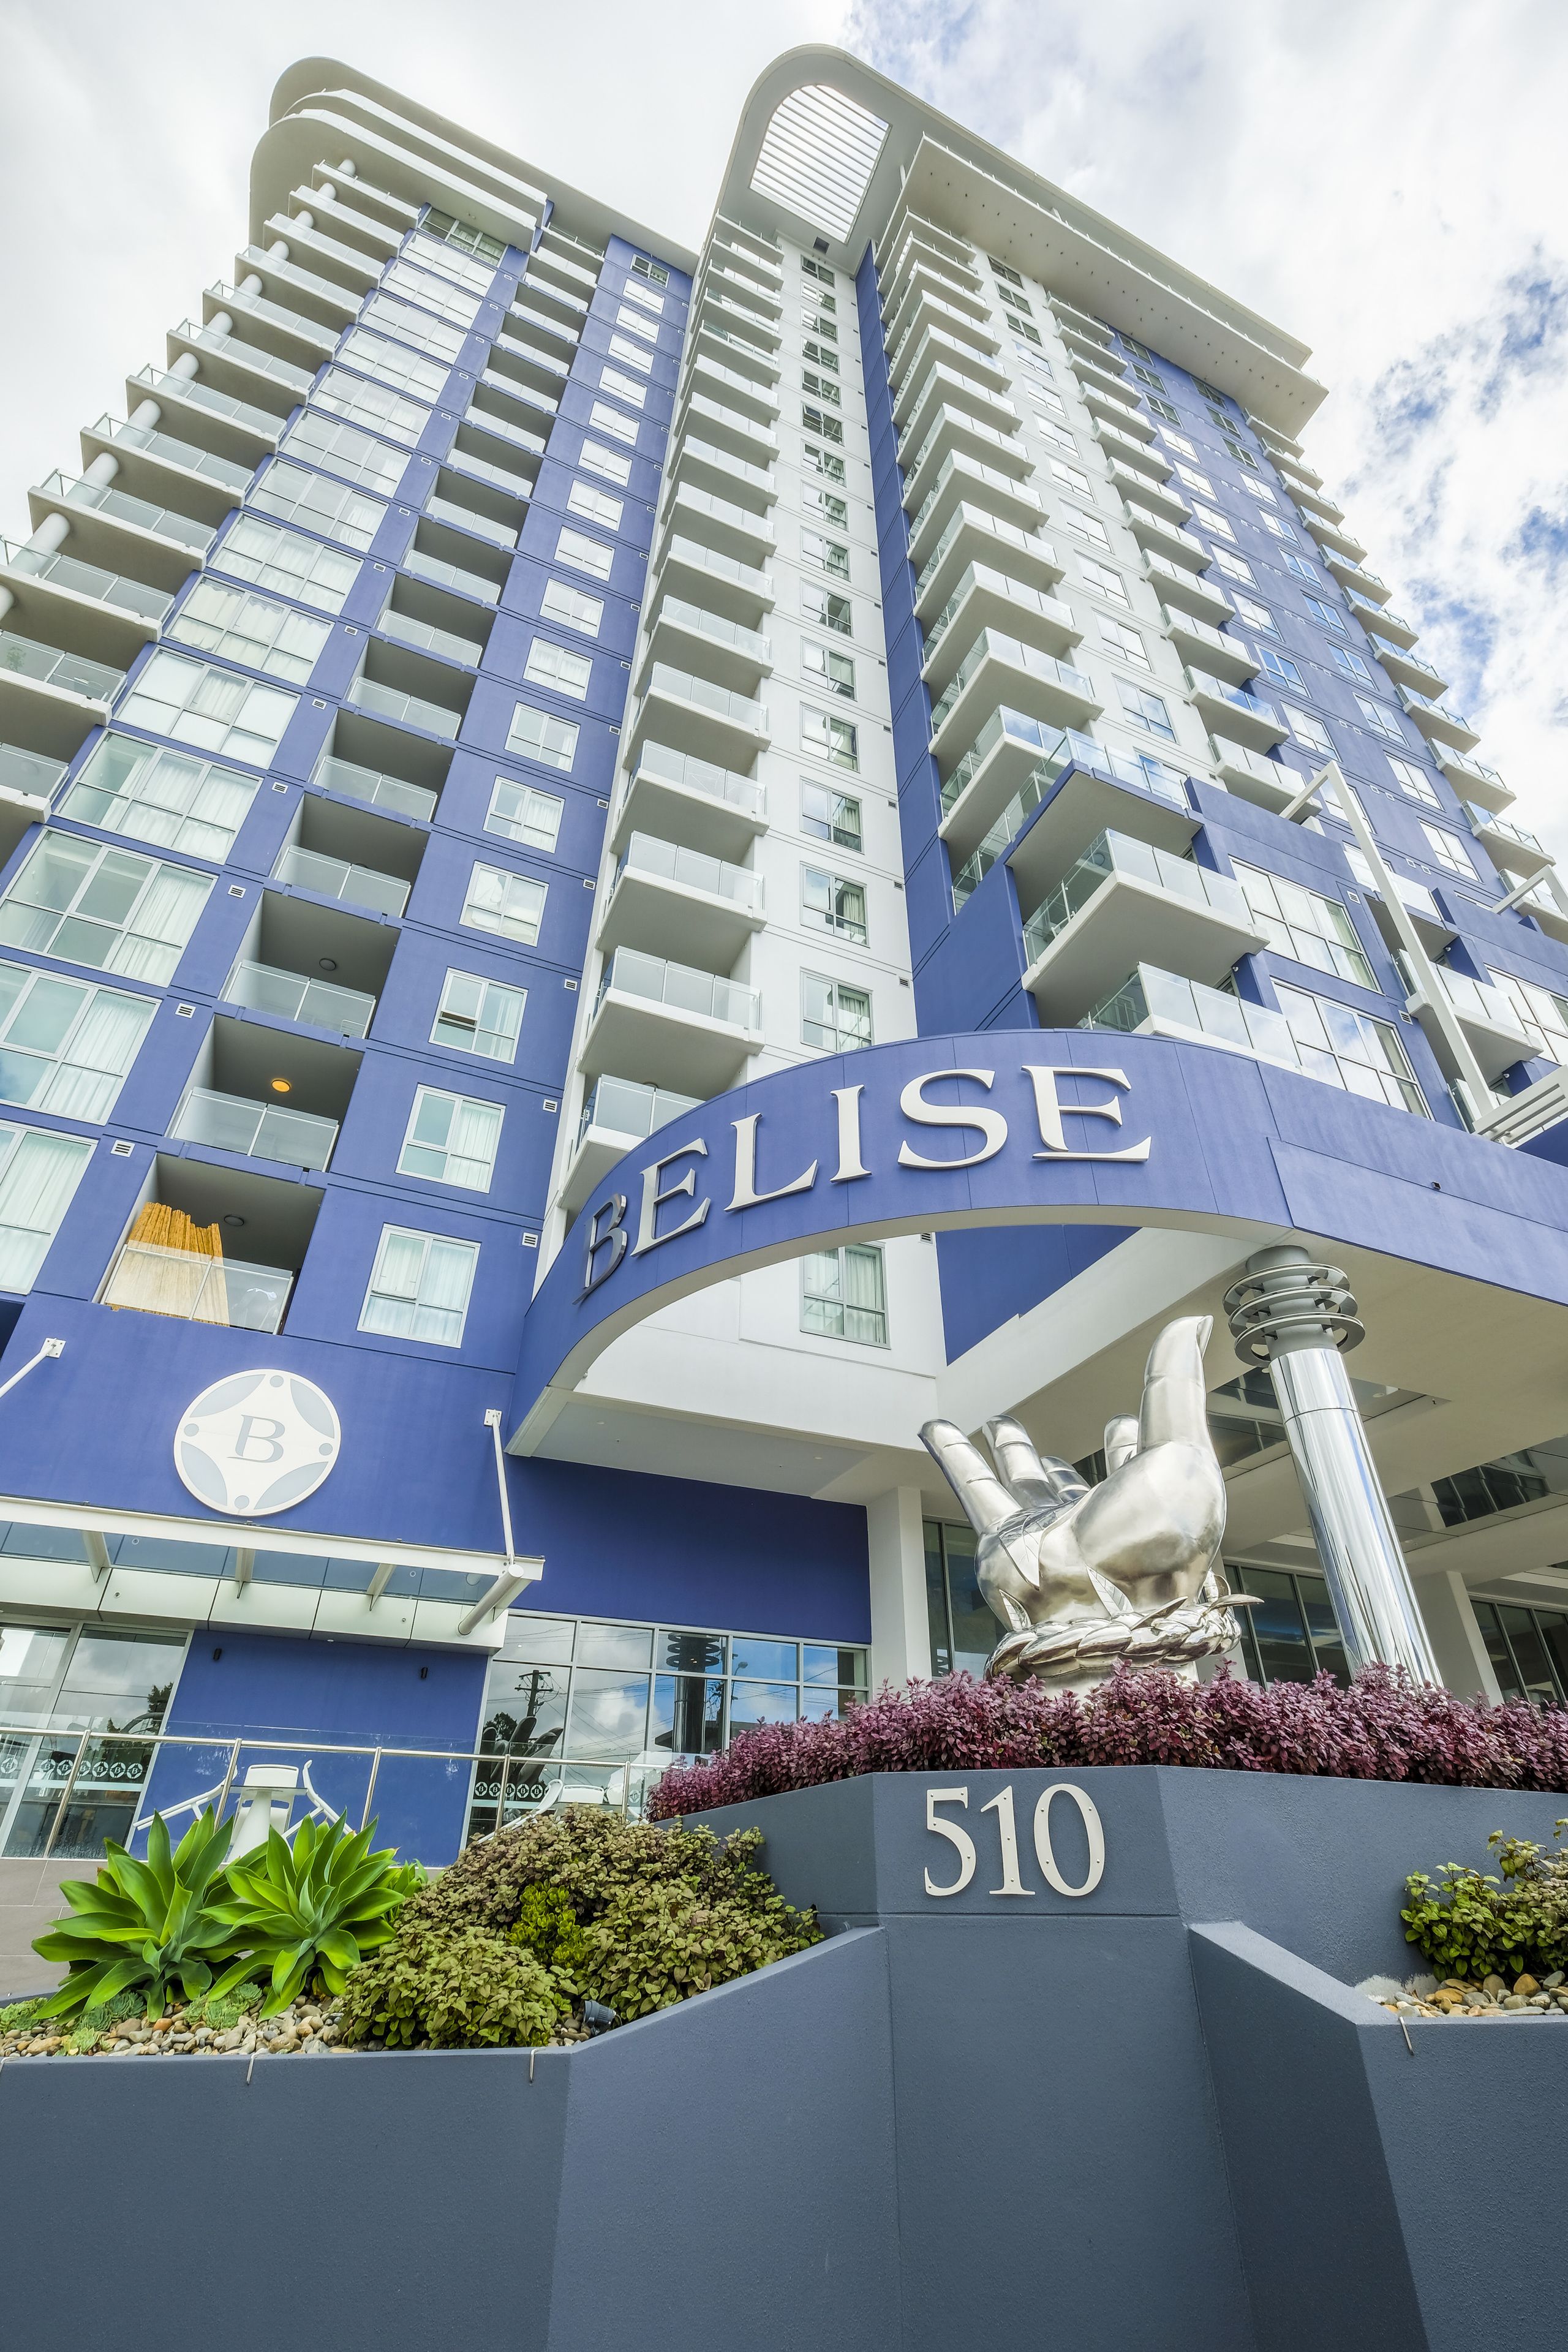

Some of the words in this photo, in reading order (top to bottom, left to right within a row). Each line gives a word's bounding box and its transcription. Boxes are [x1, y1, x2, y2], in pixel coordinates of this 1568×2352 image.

[572, 1065, 1152, 1305] BELISE
[227, 1414, 285, 1463] B
[924, 1783, 1105, 1897] 510
